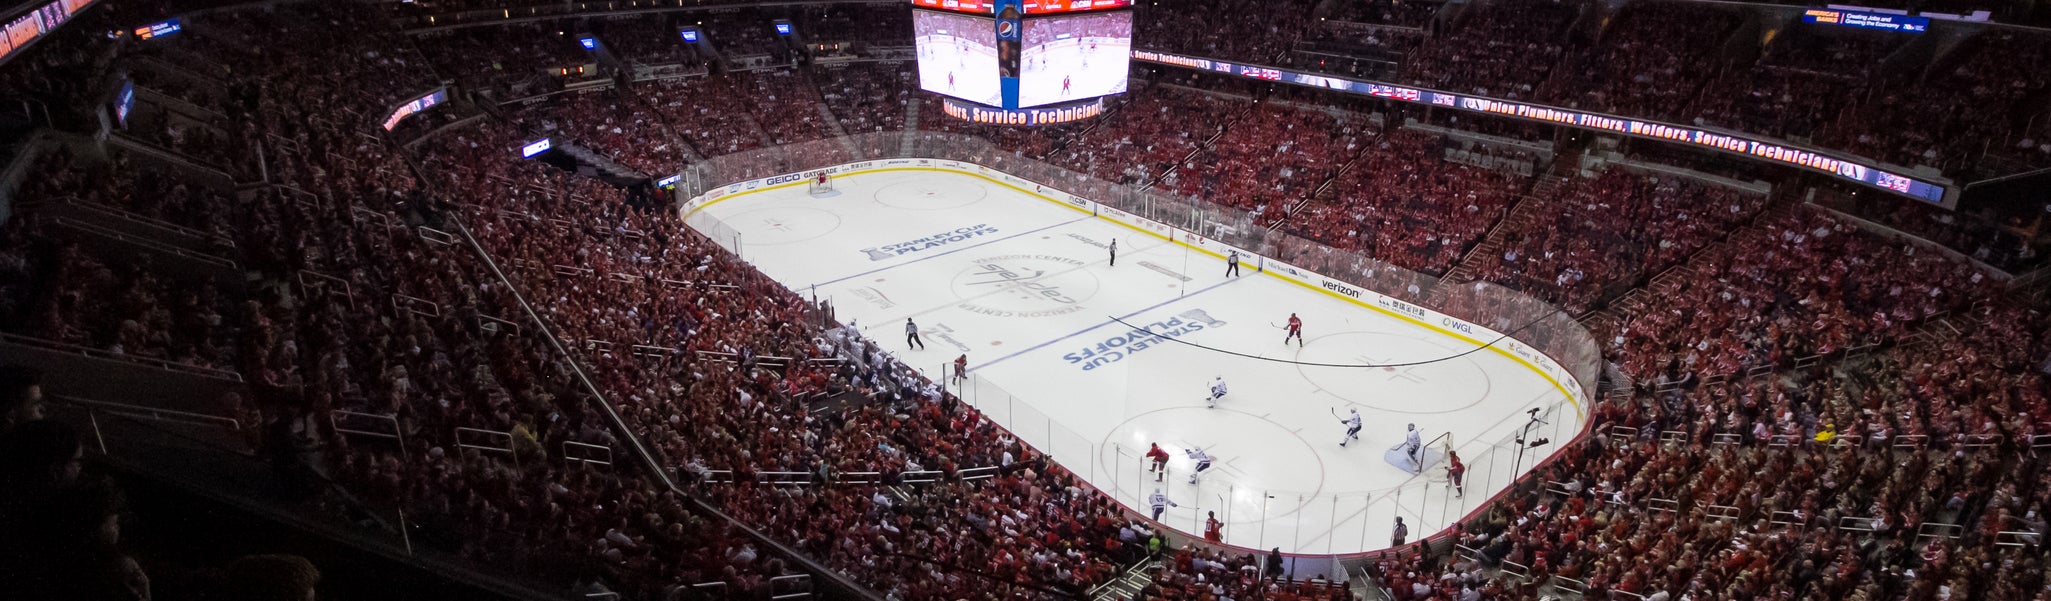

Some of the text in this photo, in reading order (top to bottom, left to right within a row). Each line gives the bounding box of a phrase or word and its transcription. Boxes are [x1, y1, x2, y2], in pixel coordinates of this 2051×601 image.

[1845, 18, 1866, 26] Growing
[1875, 21, 1900, 29] Economy
[1846, 13, 1867, 21] Creating
[1134, 50, 1197, 67] Service Technicians
[973, 107, 1027, 125] Service
[1484, 100, 1838, 172] Union Plumbers, Fitters, Welders, Service Technicians
[766, 173, 801, 186] GEICO
[1074, 197, 1087, 206] CSN
[881, 223, 986, 252] STANLEY CUP
[896, 226, 999, 255] PLAYOFFS
[972, 254, 1085, 266] VERIZON CENTER
[1268, 261, 1287, 273] Michael
[1322, 278, 1359, 299] verizon
[958, 303, 1087, 318] VERIZON CENTER
[1451, 319, 1473, 335] WGL
[1063, 316, 1183, 364] PLAYOFFS
[1082, 321, 1204, 371] STANLEY CUP
